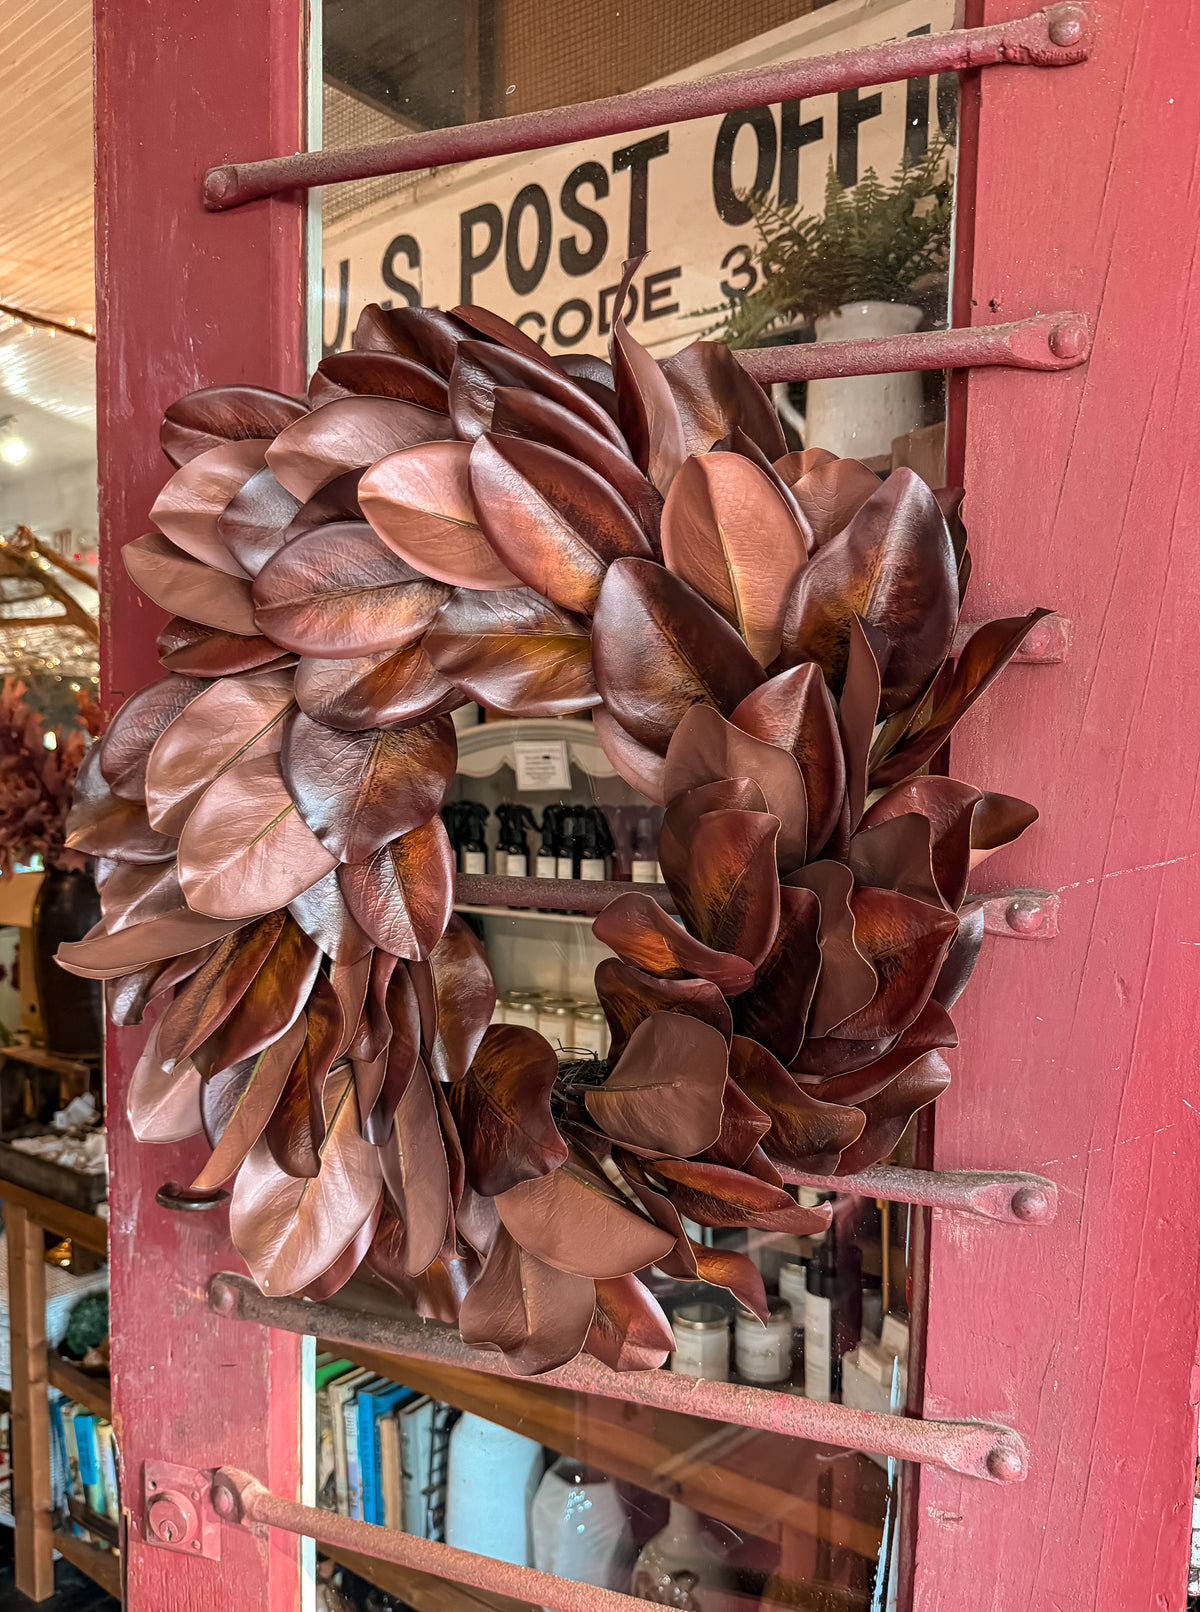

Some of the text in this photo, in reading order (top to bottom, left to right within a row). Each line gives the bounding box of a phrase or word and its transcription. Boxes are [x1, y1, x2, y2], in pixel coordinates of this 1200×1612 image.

[381, 233, 434, 309] S
[460, 131, 669, 309] POST
[514, 265, 682, 347] CODE
